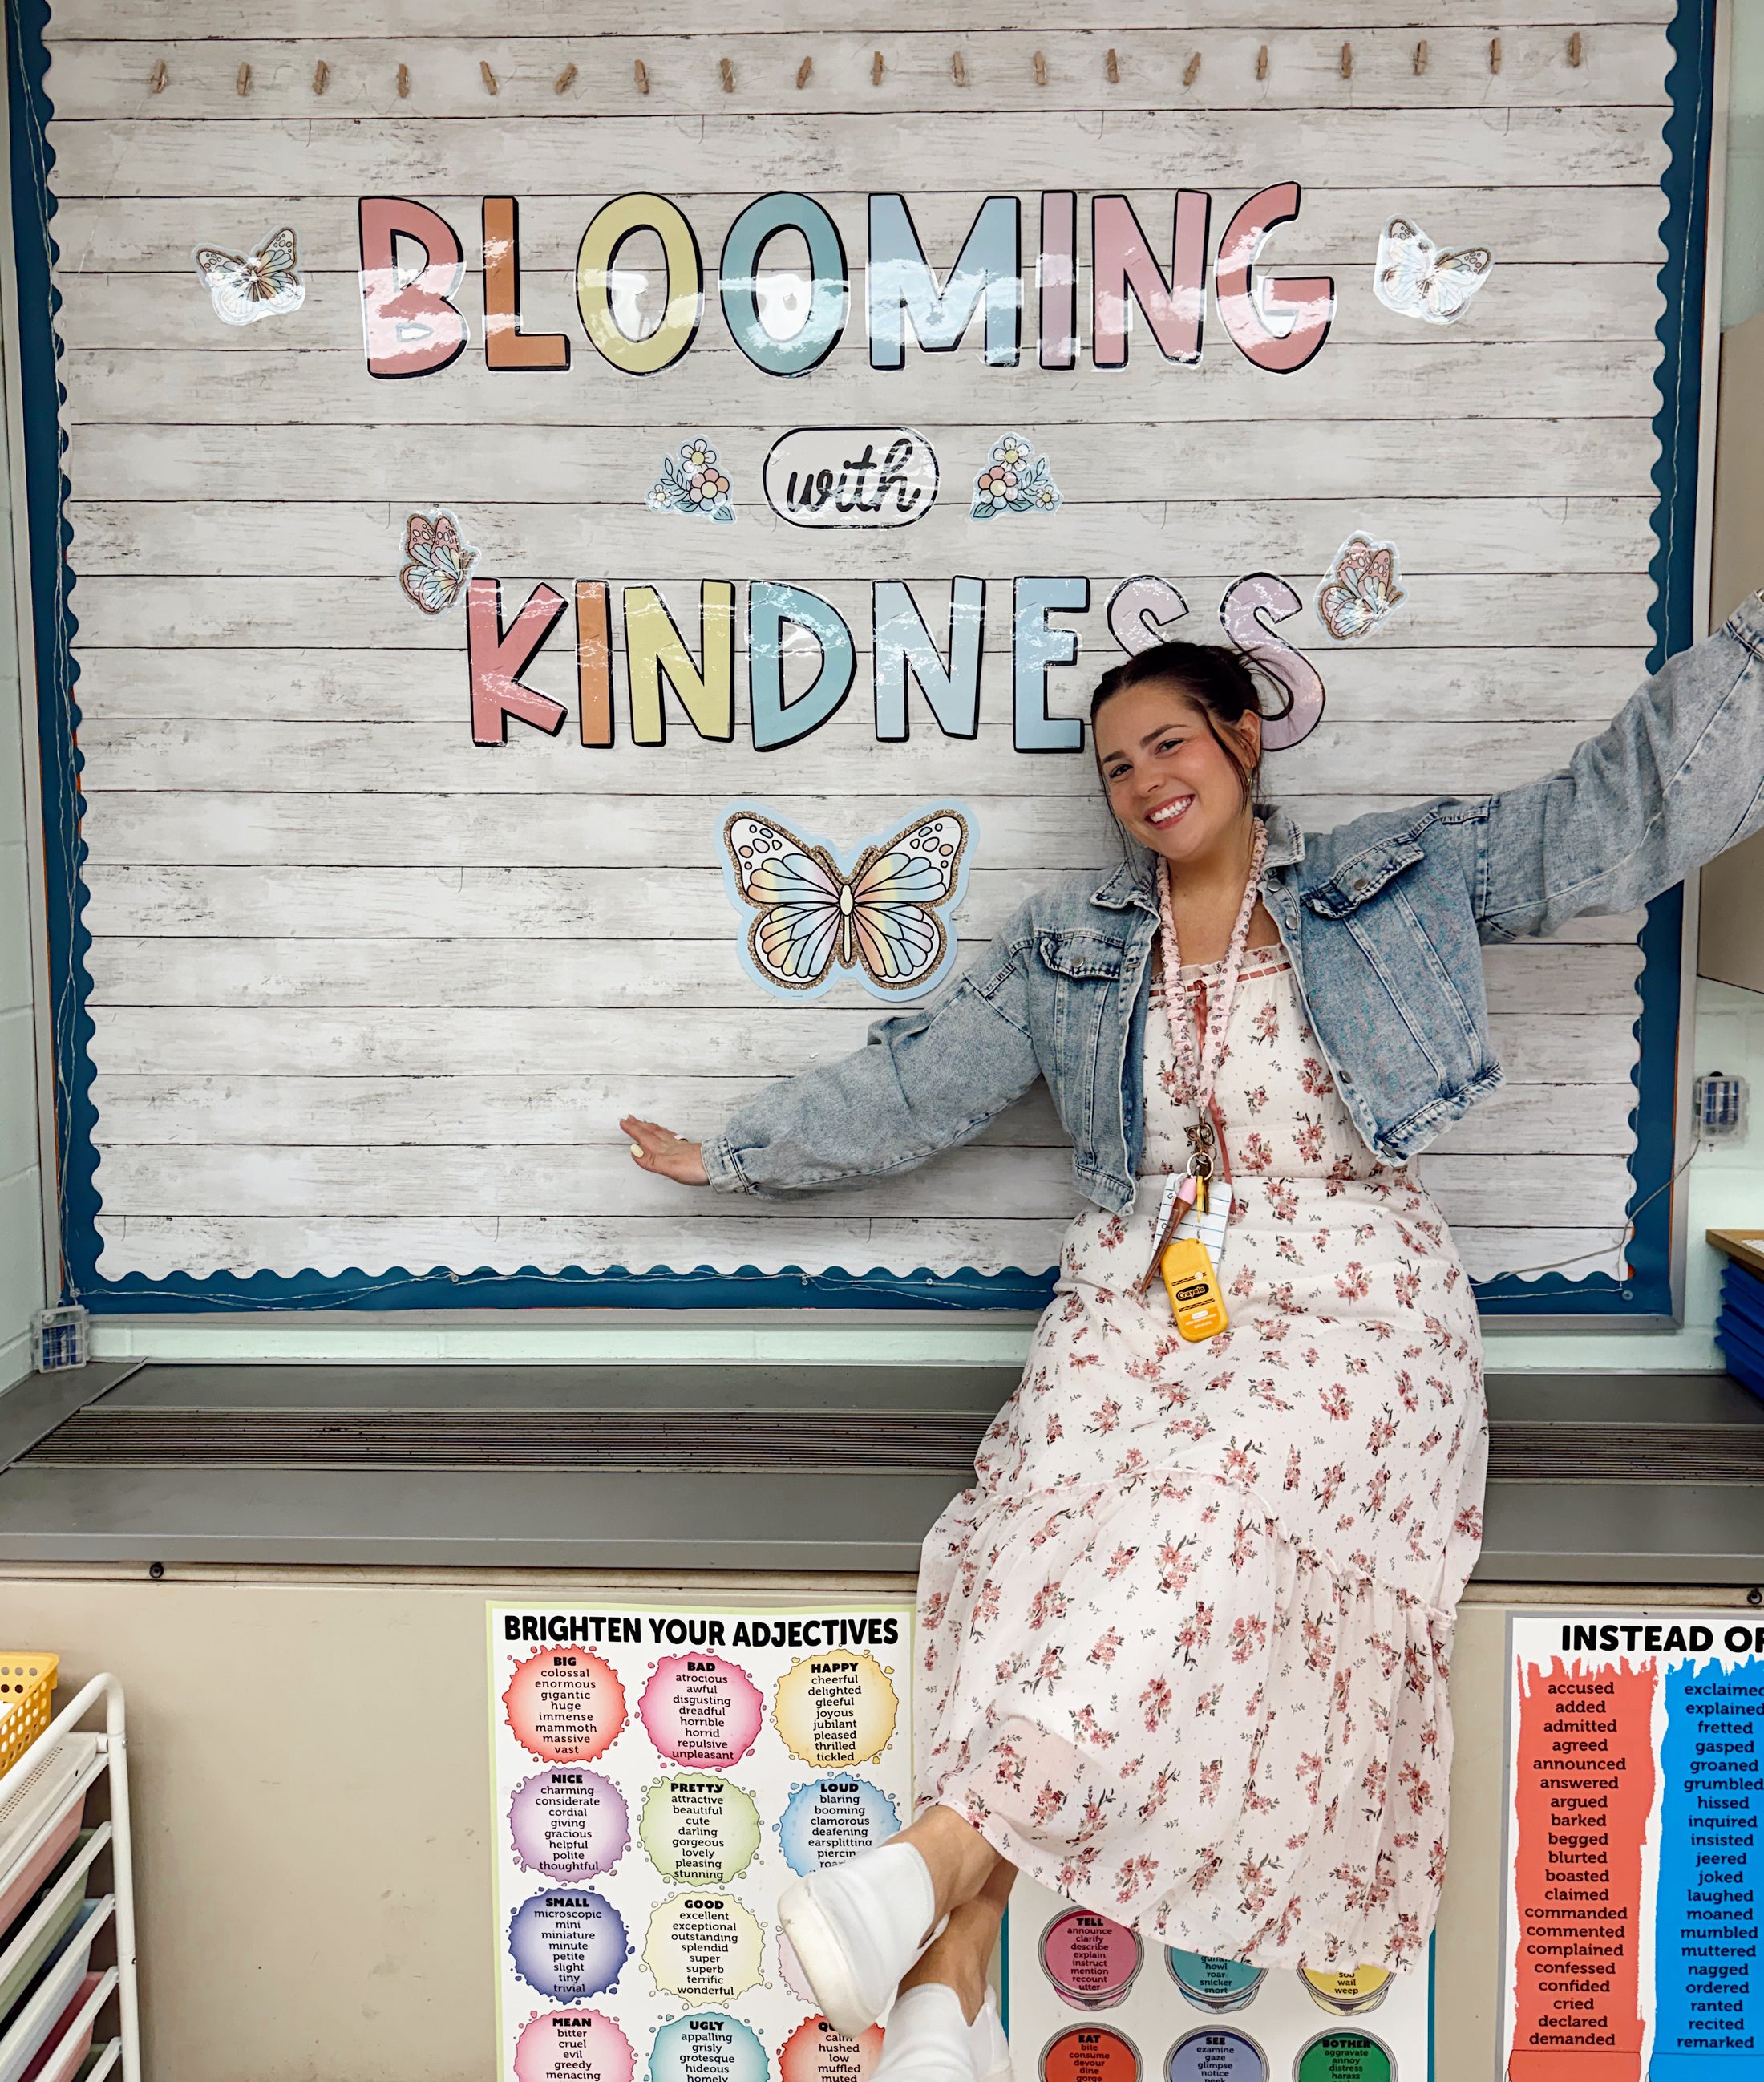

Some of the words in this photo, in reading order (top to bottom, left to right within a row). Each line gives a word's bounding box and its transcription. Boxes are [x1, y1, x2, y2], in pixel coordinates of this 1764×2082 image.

[358, 181, 1334, 379] BLOOMING
[787, 438, 921, 512] with
[1177, 1286, 1206, 1300] Crayola
[505, 1616, 641, 1643] BRIGHTEN
[649, 1618, 725, 1646] YOUR
[733, 1618, 898, 1647] ADJECTIVES
[1563, 1625, 1713, 1651] INSTEAD
[554, 1657, 576, 1666] BIG
[688, 1662, 715, 1671] BAD
[541, 1668, 589, 1677] colossal
[811, 1663, 858, 1673] HAPPY
[676, 1674, 727, 1683] atrocious
[812, 1675, 858, 1684] cheerful
[687, 1685, 717, 1693] awful
[808, 1686, 861, 1697] delighted
[1548, 1682, 1614, 1694] accused
[541, 1691, 590, 1701] gigantic
[674, 1695, 730, 1707] disgusting
[552, 1701, 581, 1711] huge
[816, 1697, 854, 1708] gleeful
[1556, 1700, 1606, 1713] added
[679, 1707, 725, 1715] dreadful
[816, 1711, 853, 1719] joyous
[1686, 1703, 1764, 1717] explained
[681, 1717, 724, 1727] horrible
[814, 1719, 856, 1731] jubilant
[1544, 1719, 1616, 1732] admitted
[1698, 1721, 1753, 1733] fretted
[536, 1724, 597, 1732] mammoth
[686, 1728, 719, 1737] horrid
[815, 1731, 856, 1741] pleased
[678, 1740, 727, 1748] repulsive
[815, 1741, 856, 1750] thrilled
[1552, 1739, 1608, 1754] agreed
[1696, 1740, 1754, 1755] gasped
[672, 1749, 734, 1760] unpleasant
[817, 1752, 854, 1761] tickled
[1534, 1758, 1626, 1770] announced
[1690, 1760, 1758, 1774] groaned
[552, 1775, 582, 1784] NICE
[1540, 1776, 1618, 1788] answered
[671, 1783, 723, 1793] PRETTY
[821, 1784, 858, 1792] LOUD
[1685, 1778, 1764, 1792] grumbled
[541, 1786, 593, 1796] charming
[536, 1797, 600, 1805] considerate
[672, 1796, 723, 1804] attractive
[820, 1795, 860, 1805] blaring
[1551, 1796, 1608, 1810] argued
[1698, 1796, 1749, 1809] hissed
[549, 1808, 586, 1816] cordial
[673, 1805, 722, 1814] beautiful
[815, 1806, 865, 1816] booming
[552, 1821, 585, 1829] giving
[811, 1817, 869, 1825] clamorous
[1552, 1814, 1606, 1826] barked
[1689, 1816, 1757, 1830] inquired
[545, 1831, 592, 1840] gracious
[678, 1827, 718, 1838] darling
[812, 1828, 868, 1837] deafening
[673, 1840, 723, 1848] gorgeous
[1548, 1833, 1608, 1848] begged
[1692, 1834, 1753, 1845] insisted
[549, 1841, 588, 1850] helpful
[553, 1851, 584, 1861] polite
[682, 1848, 714, 1859] lovely
[1548, 1851, 1607, 1863] blurted
[676, 1859, 722, 1869] pleasing
[1696, 1853, 1746, 1867] jeered
[540, 1861, 599, 1872] thoughtful
[674, 1870, 723, 1881] stunning
[1546, 1869, 1609, 1881] boasted
[1698, 1871, 1743, 1886] joked
[1545, 1888, 1608, 1900] claimed
[1688, 1890, 1753, 1904] laughed
[546, 1898, 589, 1907] SMALL
[685, 1900, 723, 1909] GOOD
[534, 1911, 601, 1920] microscopic
[680, 1911, 729, 1920] excellent
[1525, 1907, 1628, 1919] commanded
[1687, 1908, 1753, 1920] moaned
[1077, 1918, 1103, 1926] TELL
[673, 1923, 736, 1932] exceptional
[1527, 1926, 1624, 1938] commented
[1681, 1926, 1758, 1938] mumbled
[672, 1933, 738, 1944] outstanding
[1076, 1935, 1103, 1944] clarify
[682, 1943, 728, 1953] splendid
[1071, 1942, 1108, 1950] describe
[1527, 1943, 1624, 1958] complained
[1682, 1945, 1756, 1957] muttered
[553, 1953, 584, 1962] petite
[1074, 1951, 1106, 1959] explain
[554, 1963, 584, 1973] slight
[687, 1965, 723, 1975] superb
[1535, 1962, 1616, 1974] confessed
[1689, 1963, 1748, 1978] nagged
[559, 1975, 580, 1983] tiny
[687, 1975, 723, 1983] terrific
[554, 1984, 585, 1992] trivial
[678, 1987, 734, 1995] wonderful
[1539, 1980, 1610, 1992] confided
[1686, 1982, 1749, 1993] ordered
[1554, 1998, 1594, 2009] cried
[1691, 2000, 1742, 2011] ranted
[553, 2018, 591, 2027] MEAN
[690, 2021, 724, 2030] UGLY
[1539, 2015, 1608, 2027] declared
[1689, 2019, 1744, 2030] recited
[558, 2029, 586, 2037] bitter
[559, 2039, 586, 2048] cruel
[682, 2033, 732, 2044] appalling
[1206, 2037, 1225, 2045] SEE
[1323, 2039, 1371, 2048] BOTHER
[1529, 2033, 1615, 2045] demanded
[1677, 2036, 1754, 2048] remarked
[693, 2044, 722, 2054] grisly
[819, 2044, 860, 2052] hushed
[680, 2055, 734, 2064] grotesque
[830, 2054, 849, 2062] low
[555, 2061, 591, 2071] greedy
[686, 2064, 729, 2072] hideous
[819, 2064, 860, 2072] muffled
[547, 2072, 600, 2081] menacing
